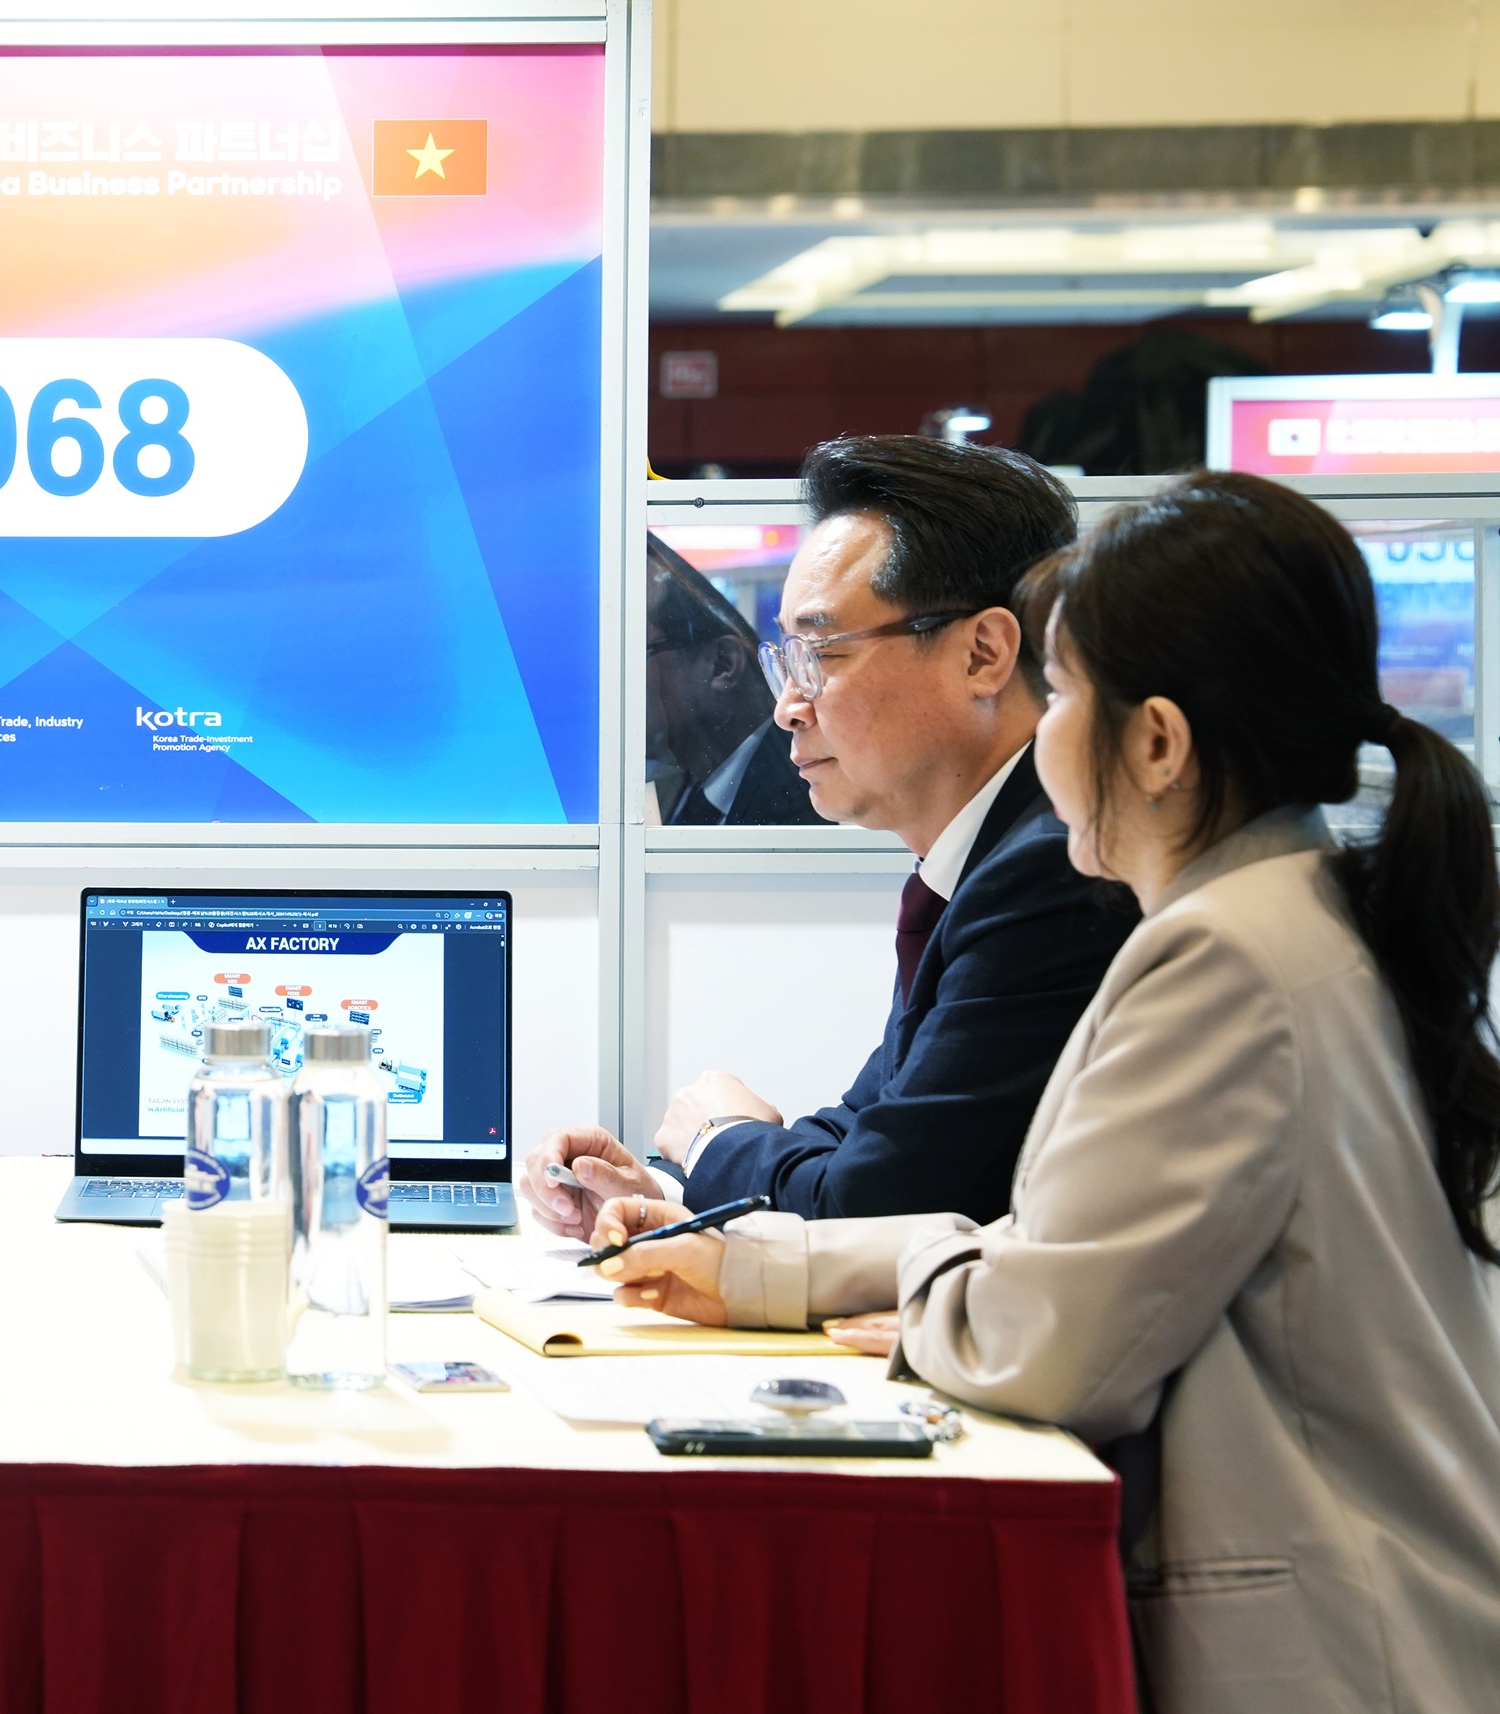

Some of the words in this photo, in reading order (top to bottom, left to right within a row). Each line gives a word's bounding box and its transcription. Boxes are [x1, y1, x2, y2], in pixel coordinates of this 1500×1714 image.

[0, 120, 163, 162] 비즈니스
[175, 120, 340, 162] 파트너십
[28, 171, 159, 195] Business
[168, 171, 342, 201] Partnership
[35, 716, 84, 730] Industry
[136, 706, 222, 731] kotra
[152, 735, 178, 743] Korea
[179, 735, 254, 744] Trade-Investment
[152, 743, 197, 752] Promotion
[198, 744, 231, 753] Agency
[245, 936, 267, 951] AX
[270, 937, 340, 951] FACTORY
